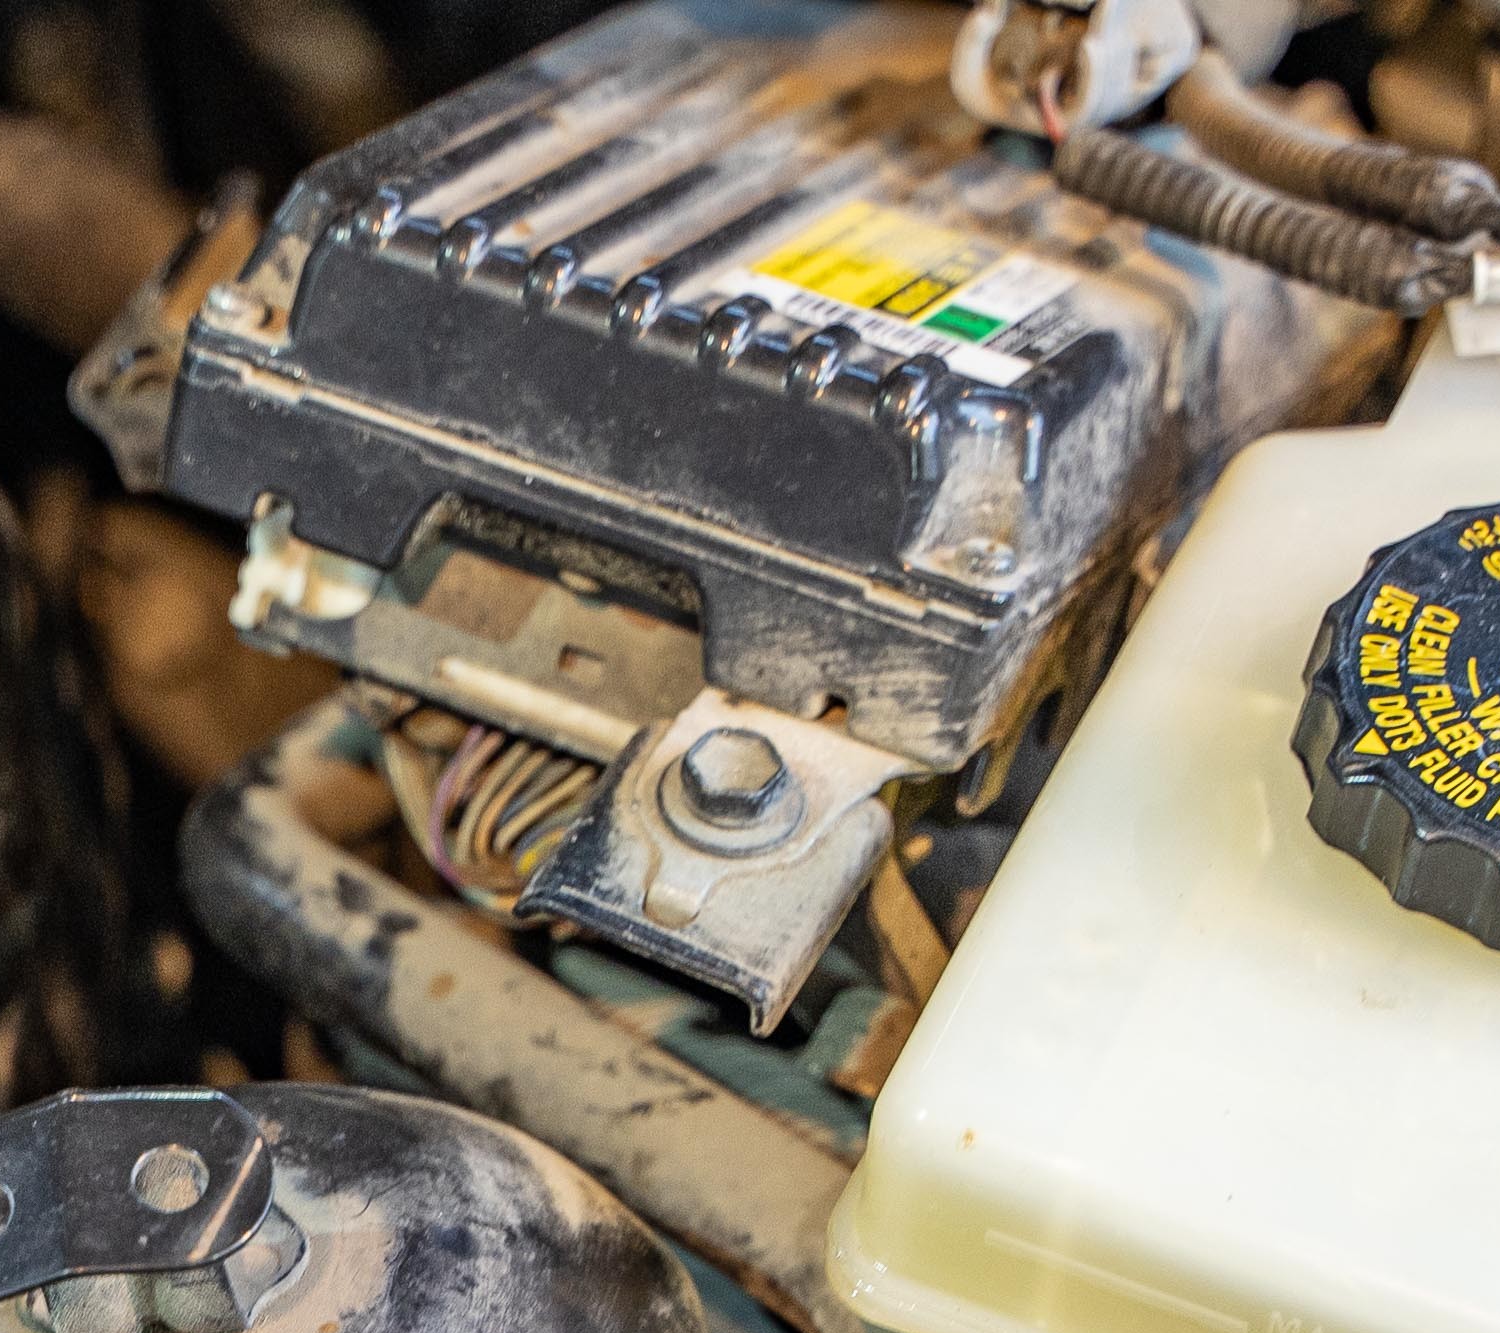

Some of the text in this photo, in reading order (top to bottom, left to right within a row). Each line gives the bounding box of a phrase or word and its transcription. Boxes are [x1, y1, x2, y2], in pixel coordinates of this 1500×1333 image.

[1367, 584, 1418, 636] USE
[1359, 636, 1403, 688] ONLY
[1408, 604, 1461, 677] CLEAN
[1368, 694, 1427, 752] DOT3
[1411, 683, 1484, 759] FILLER
[1408, 749, 1484, 809] FLUID
